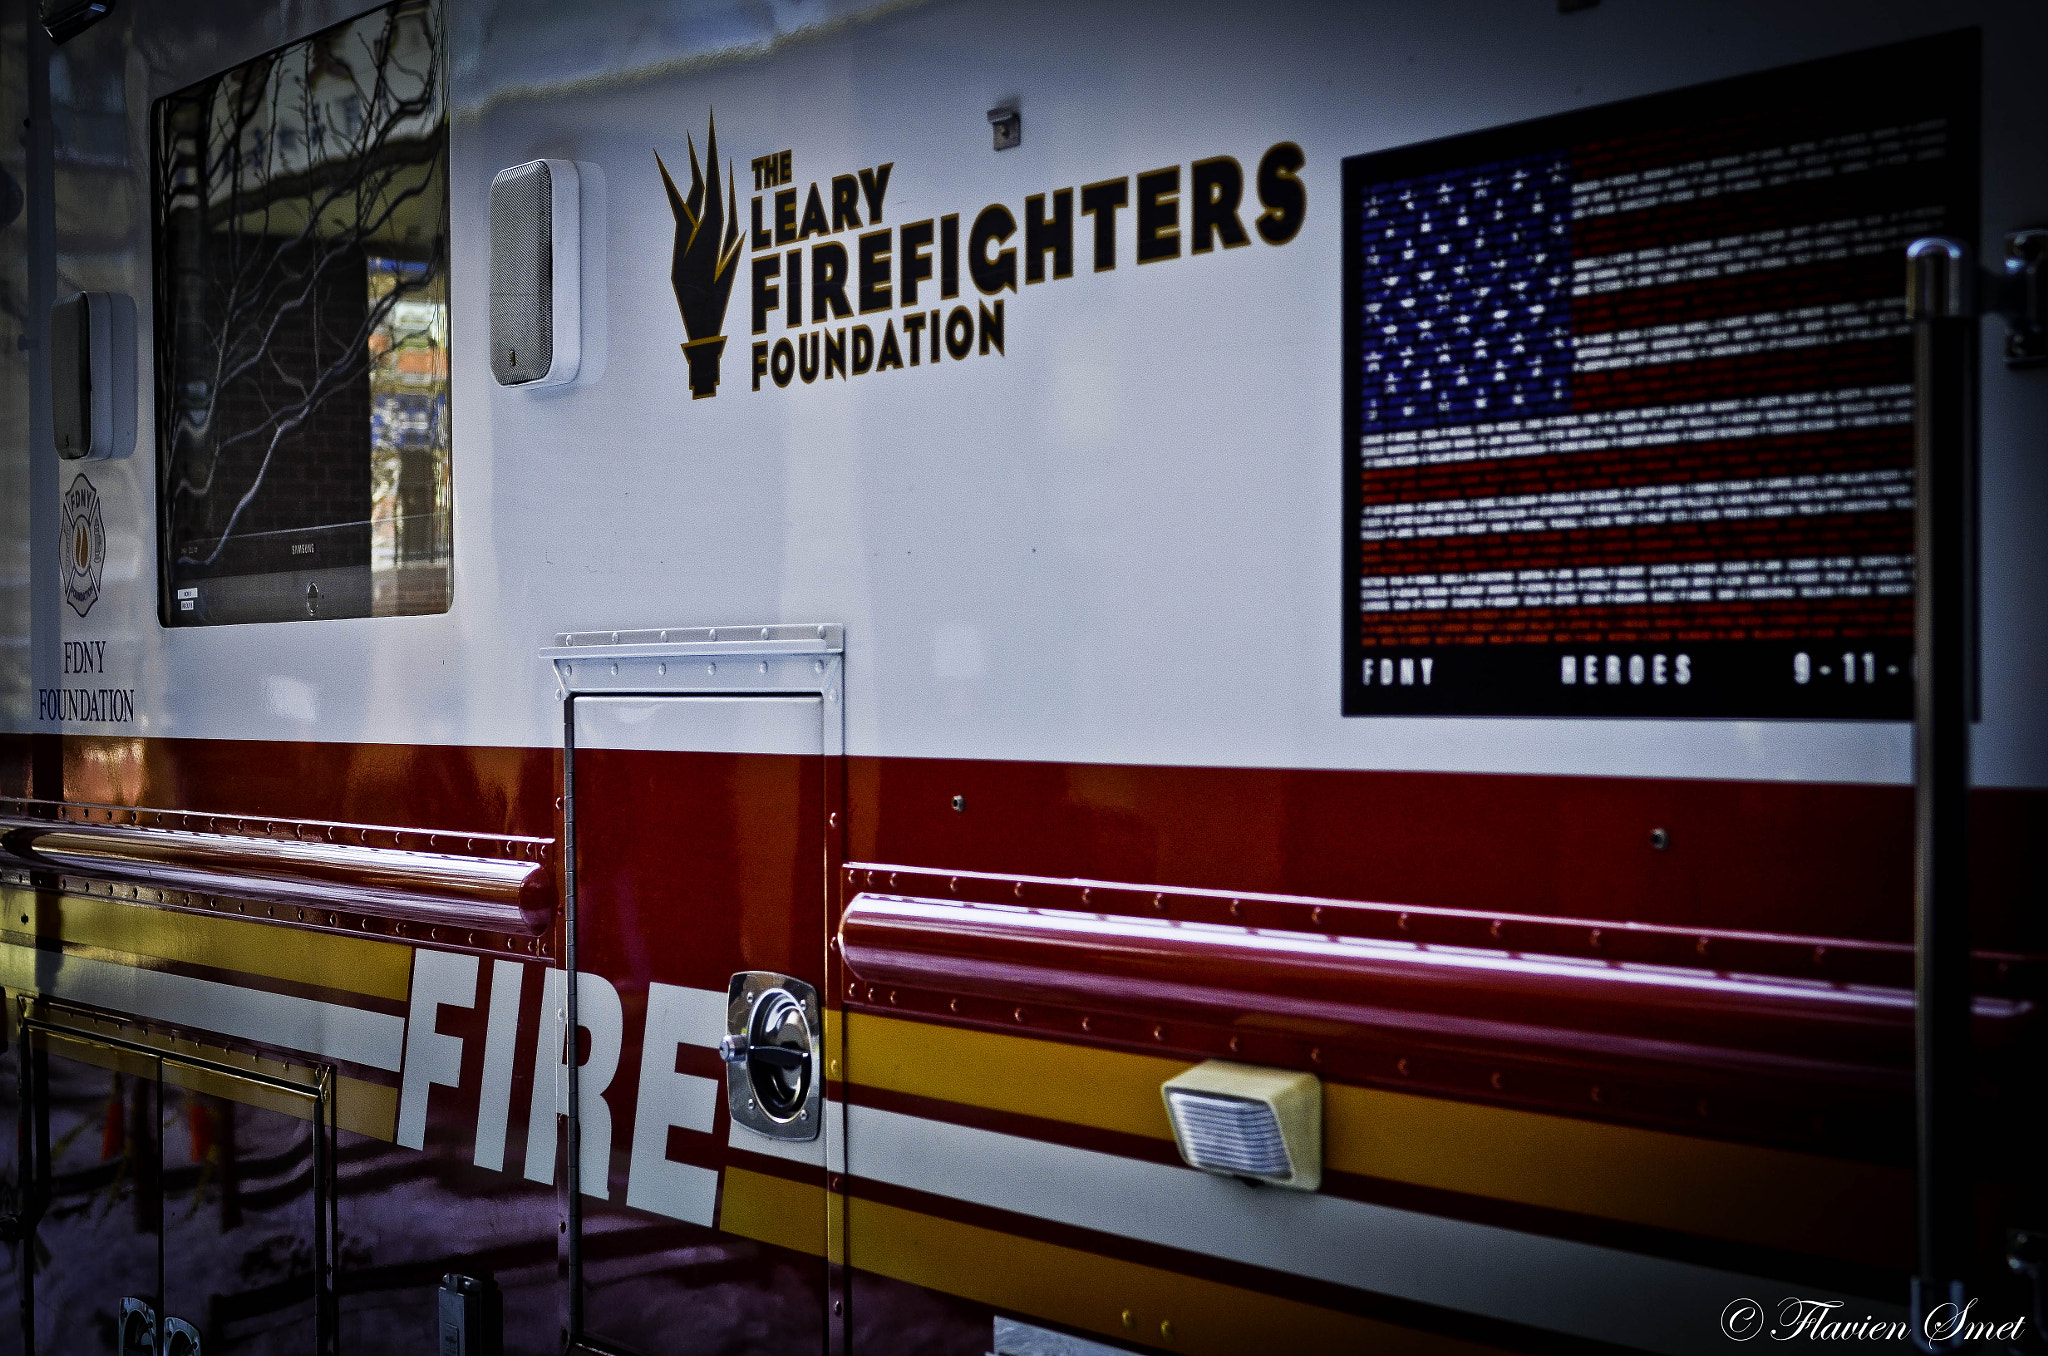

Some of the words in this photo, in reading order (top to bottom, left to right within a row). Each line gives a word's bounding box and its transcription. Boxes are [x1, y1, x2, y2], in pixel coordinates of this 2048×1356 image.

[750, 149, 793, 192] THE
[750, 161, 895, 253] LEARY
[750, 141, 1307, 336] FIREFIGHTERS
[750, 299, 1006, 393] FOUNDATION
[70, 489, 92, 513] FDNY
[291, 543, 315, 555] SAMSUNG
[64, 640, 107, 674] FDNY
[1361, 656, 1434, 686] FDNY
[1560, 652, 1692, 686] HEROES
[1792, 650, 1914, 686] 9-11-
[38, 688, 135, 723] FOUNDATION
[396, 947, 728, 1228] FIRE
